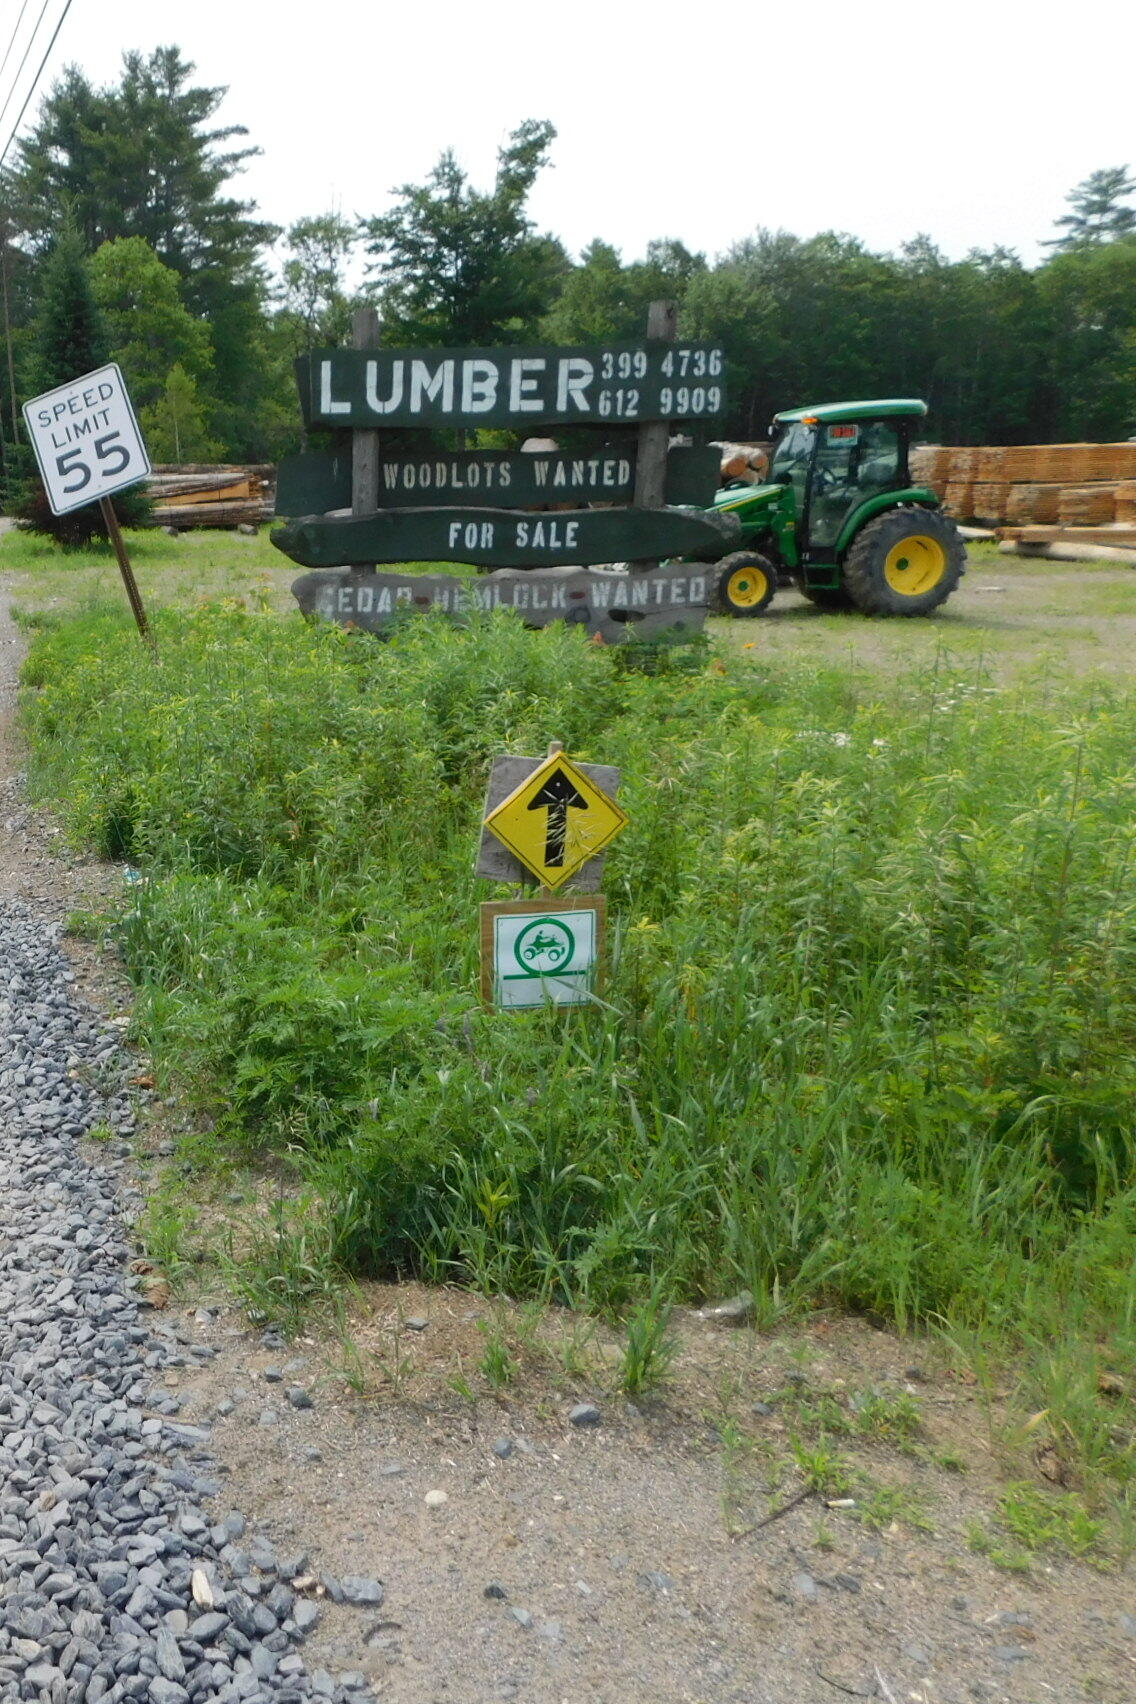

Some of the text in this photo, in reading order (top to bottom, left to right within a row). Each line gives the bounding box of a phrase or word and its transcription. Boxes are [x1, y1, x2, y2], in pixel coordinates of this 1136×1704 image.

[601, 349, 722, 379] 399 4736
[320, 357, 595, 415] LUMBER
[598, 386, 721, 417] 612 9909
[37, 383, 114, 428] SPEED
[50, 407, 111, 449] LIMIT
[55, 430, 131, 494] 55
[383, 459, 631, 490] WOODLOTS WANTED
[448, 521, 580, 549] FOR SALE
[592, 576, 706, 607] WANTED
